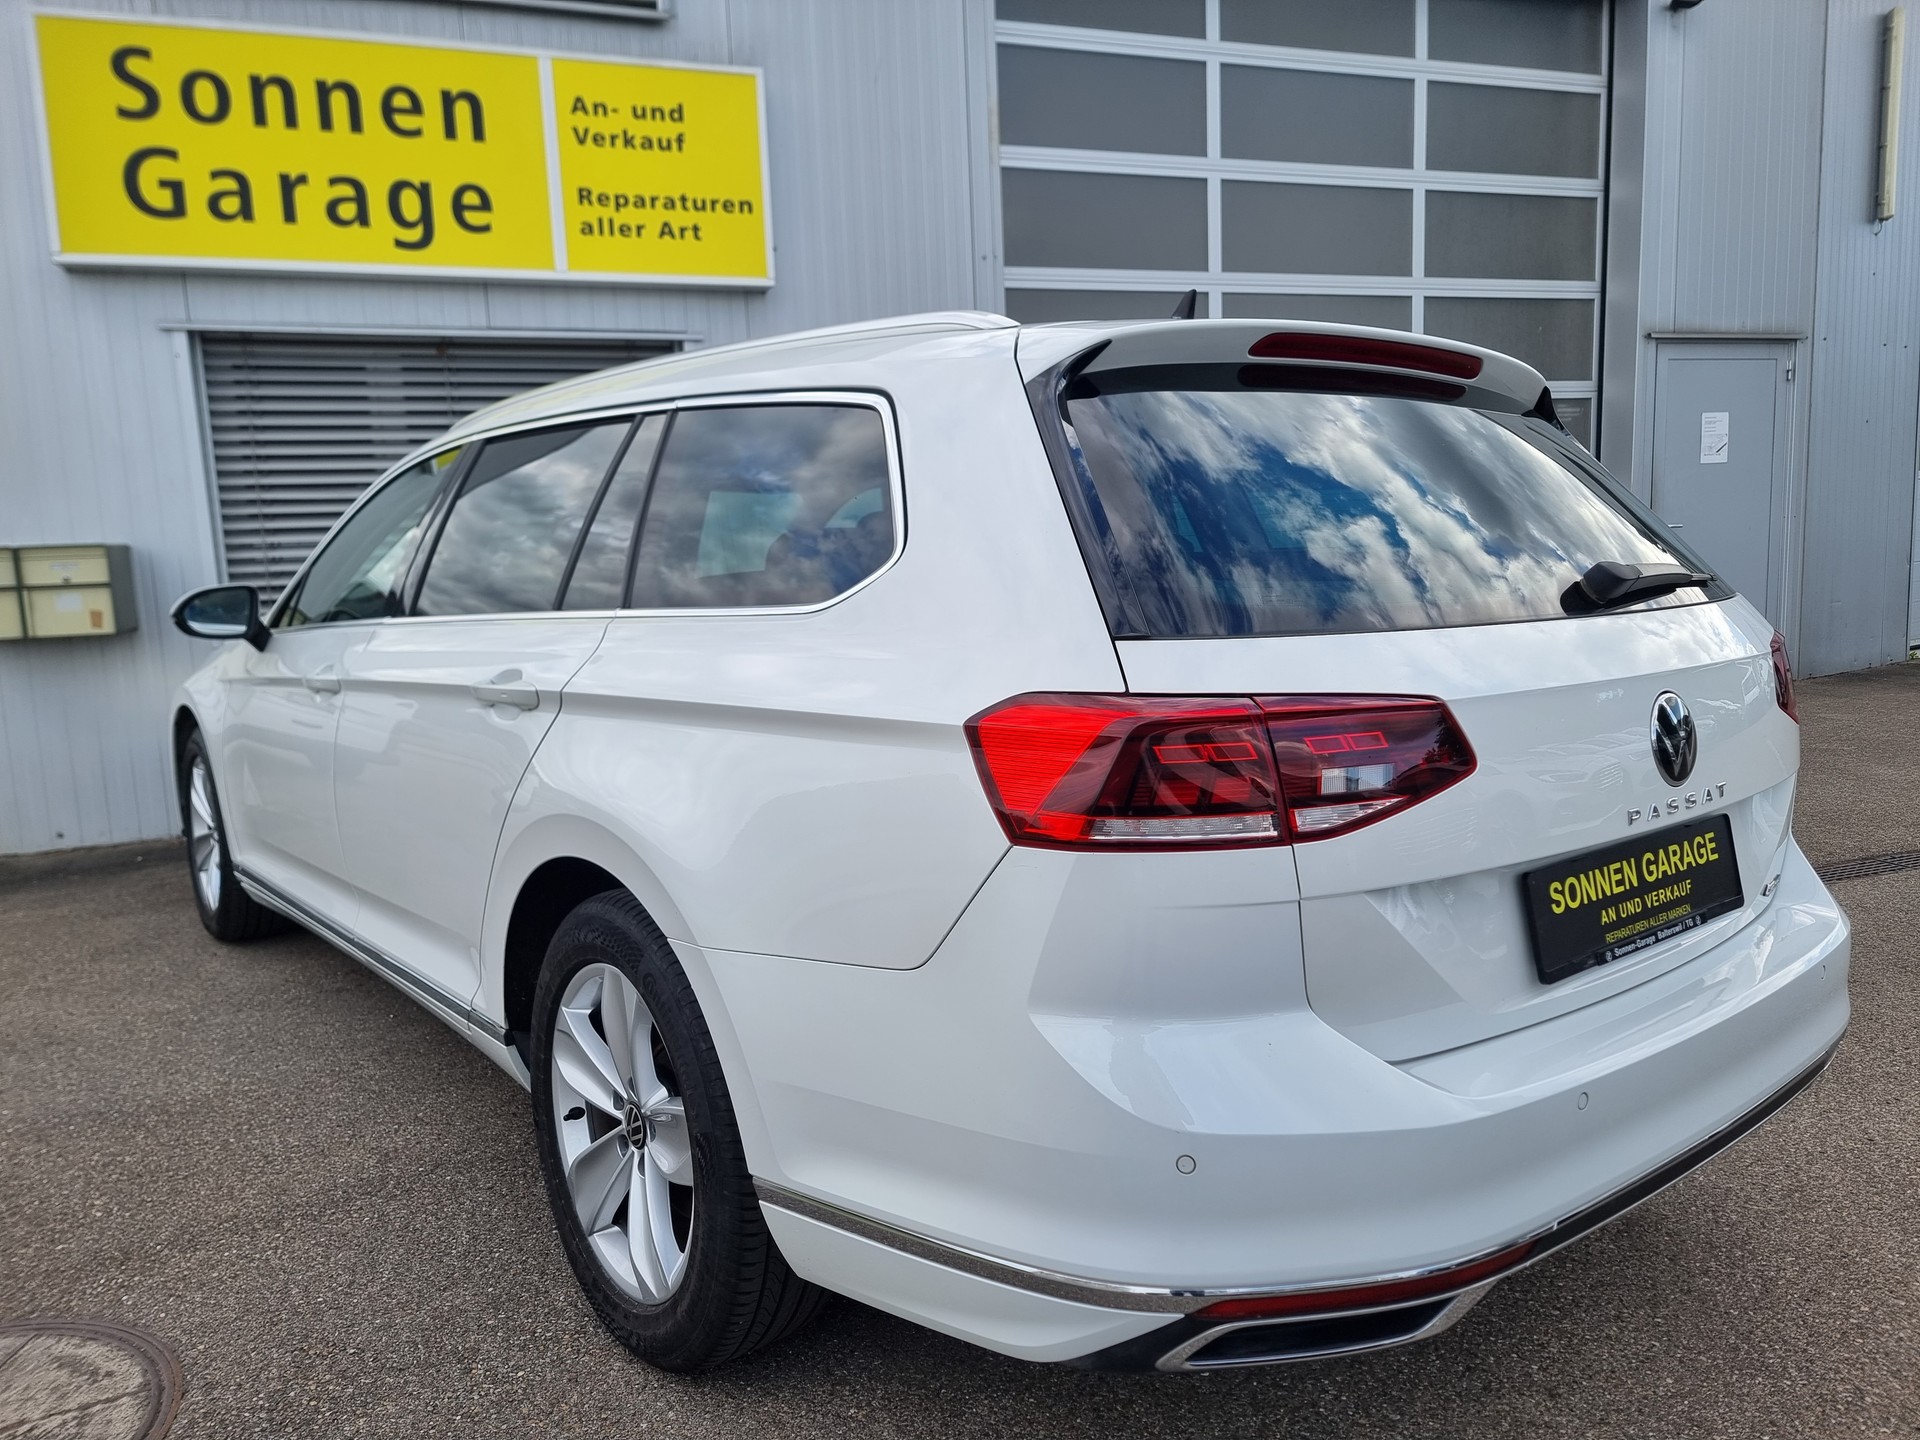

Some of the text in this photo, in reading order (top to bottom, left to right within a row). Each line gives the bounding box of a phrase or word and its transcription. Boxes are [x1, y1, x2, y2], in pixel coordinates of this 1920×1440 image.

[110, 45, 487, 143] Sonnen
[571, 96, 685, 124] An- und
[571, 126, 686, 153] Verkauf
[121, 146, 495, 251] Garage
[577, 186, 754, 215] Reparaturen
[579, 217, 704, 241] aller Art
[1627, 781, 1728, 826] PASSAT
[1550, 832, 1719, 914] SONNEN GARAGE
[1601, 880, 1692, 926] AN UND VERKAUF
[1604, 903, 1692, 944] REPARATUREN ALLER MARKEN
[1614, 935, 1656, 957] Sonnen-Garage
